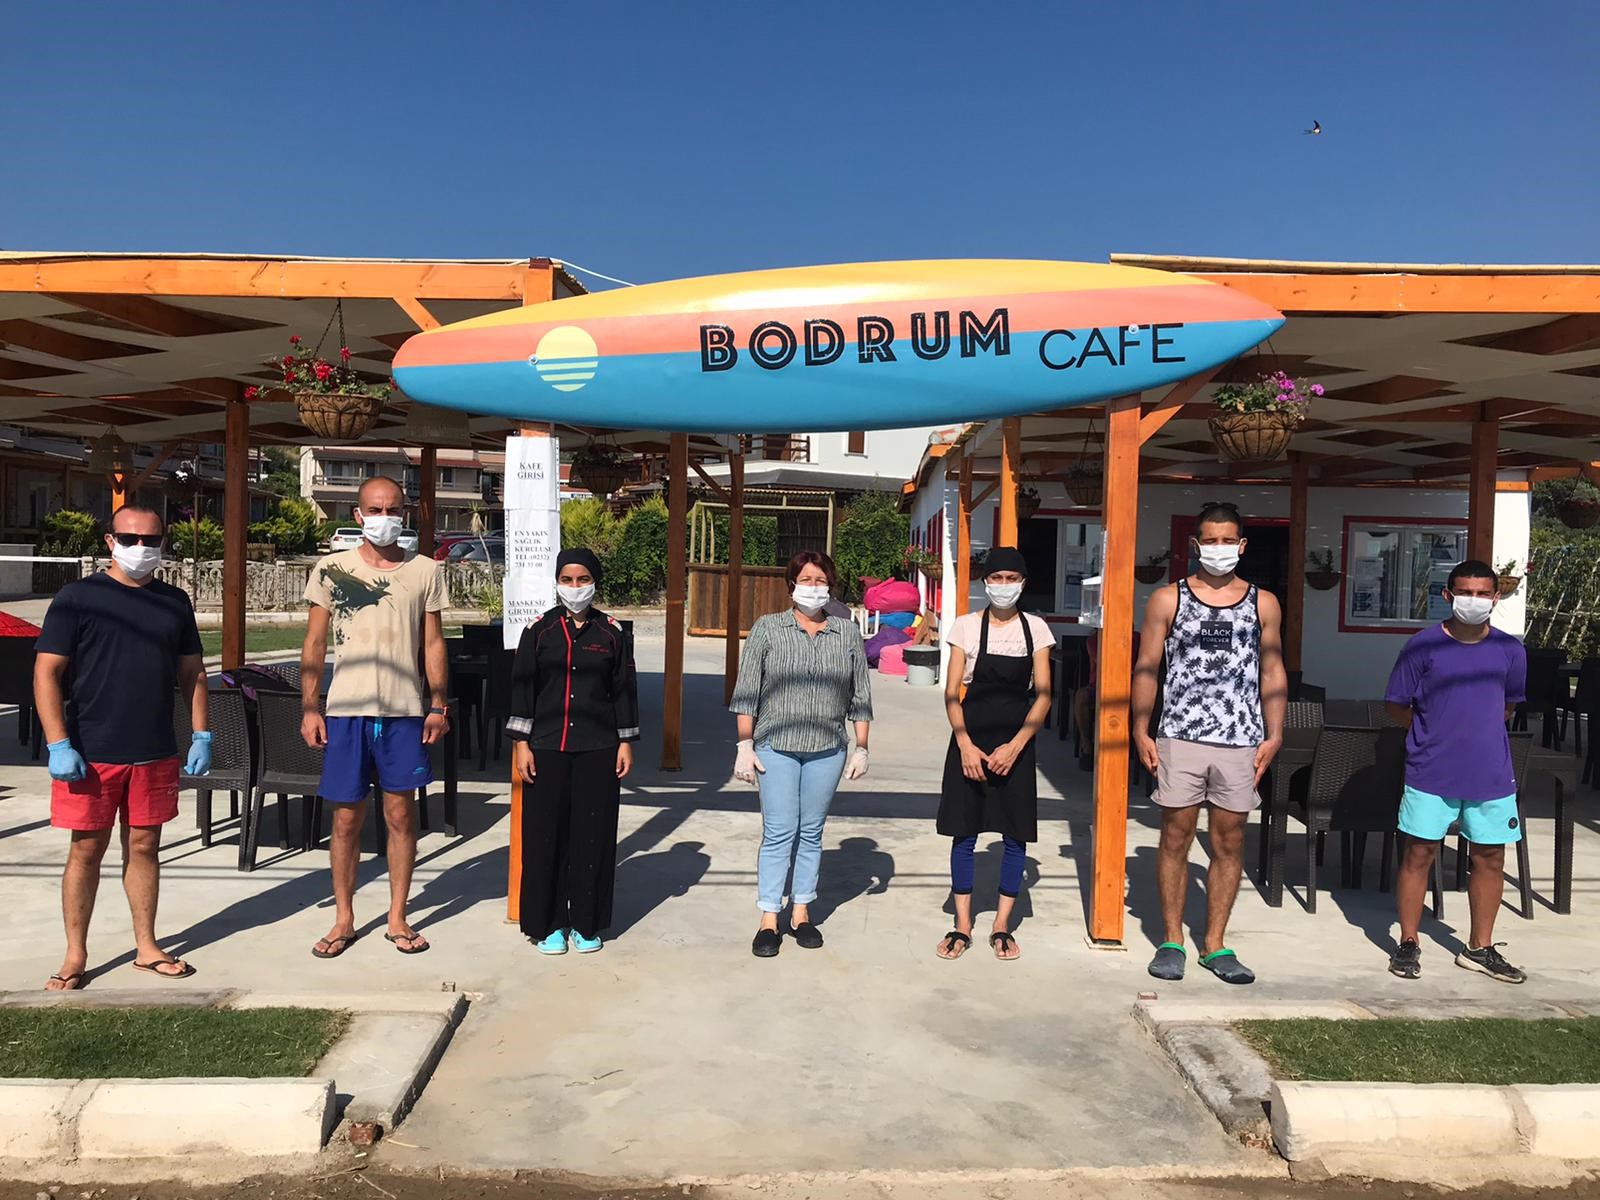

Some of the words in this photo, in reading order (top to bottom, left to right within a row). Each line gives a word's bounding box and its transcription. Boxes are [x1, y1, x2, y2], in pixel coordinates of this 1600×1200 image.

[700, 308, 1011, 372] BODRUM
[1038, 322, 1186, 371] CAFE
[519, 462, 543, 471] KAFE
[1201, 628, 1231, 637] BLACK
